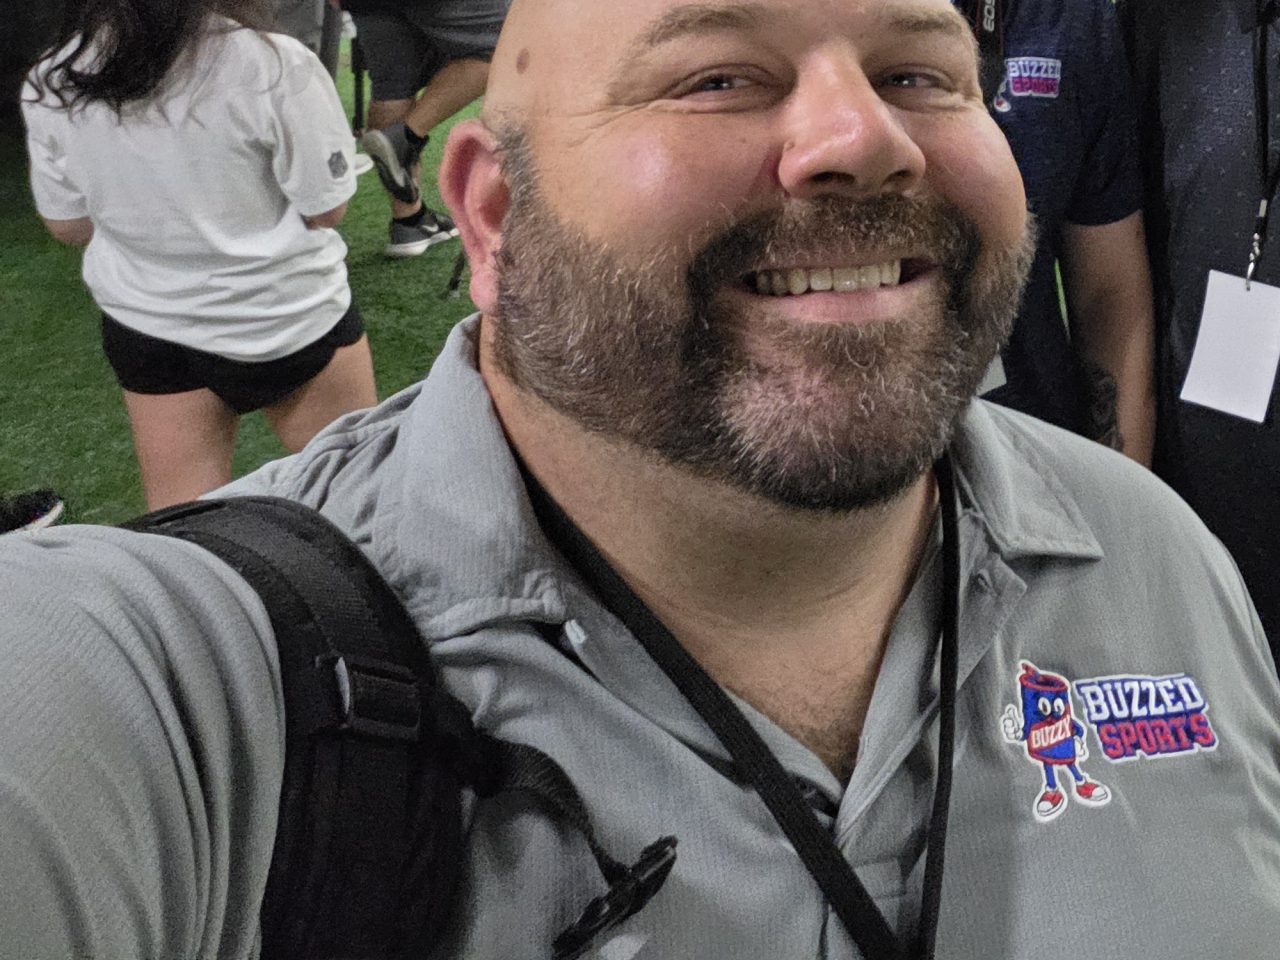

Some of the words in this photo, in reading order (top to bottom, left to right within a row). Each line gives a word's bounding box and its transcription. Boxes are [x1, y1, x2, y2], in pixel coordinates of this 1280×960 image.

[1079, 675, 1205, 721] BUZZED
[1031, 715, 1072, 749] BUZZY
[1099, 712, 1216, 759] SPORTS
